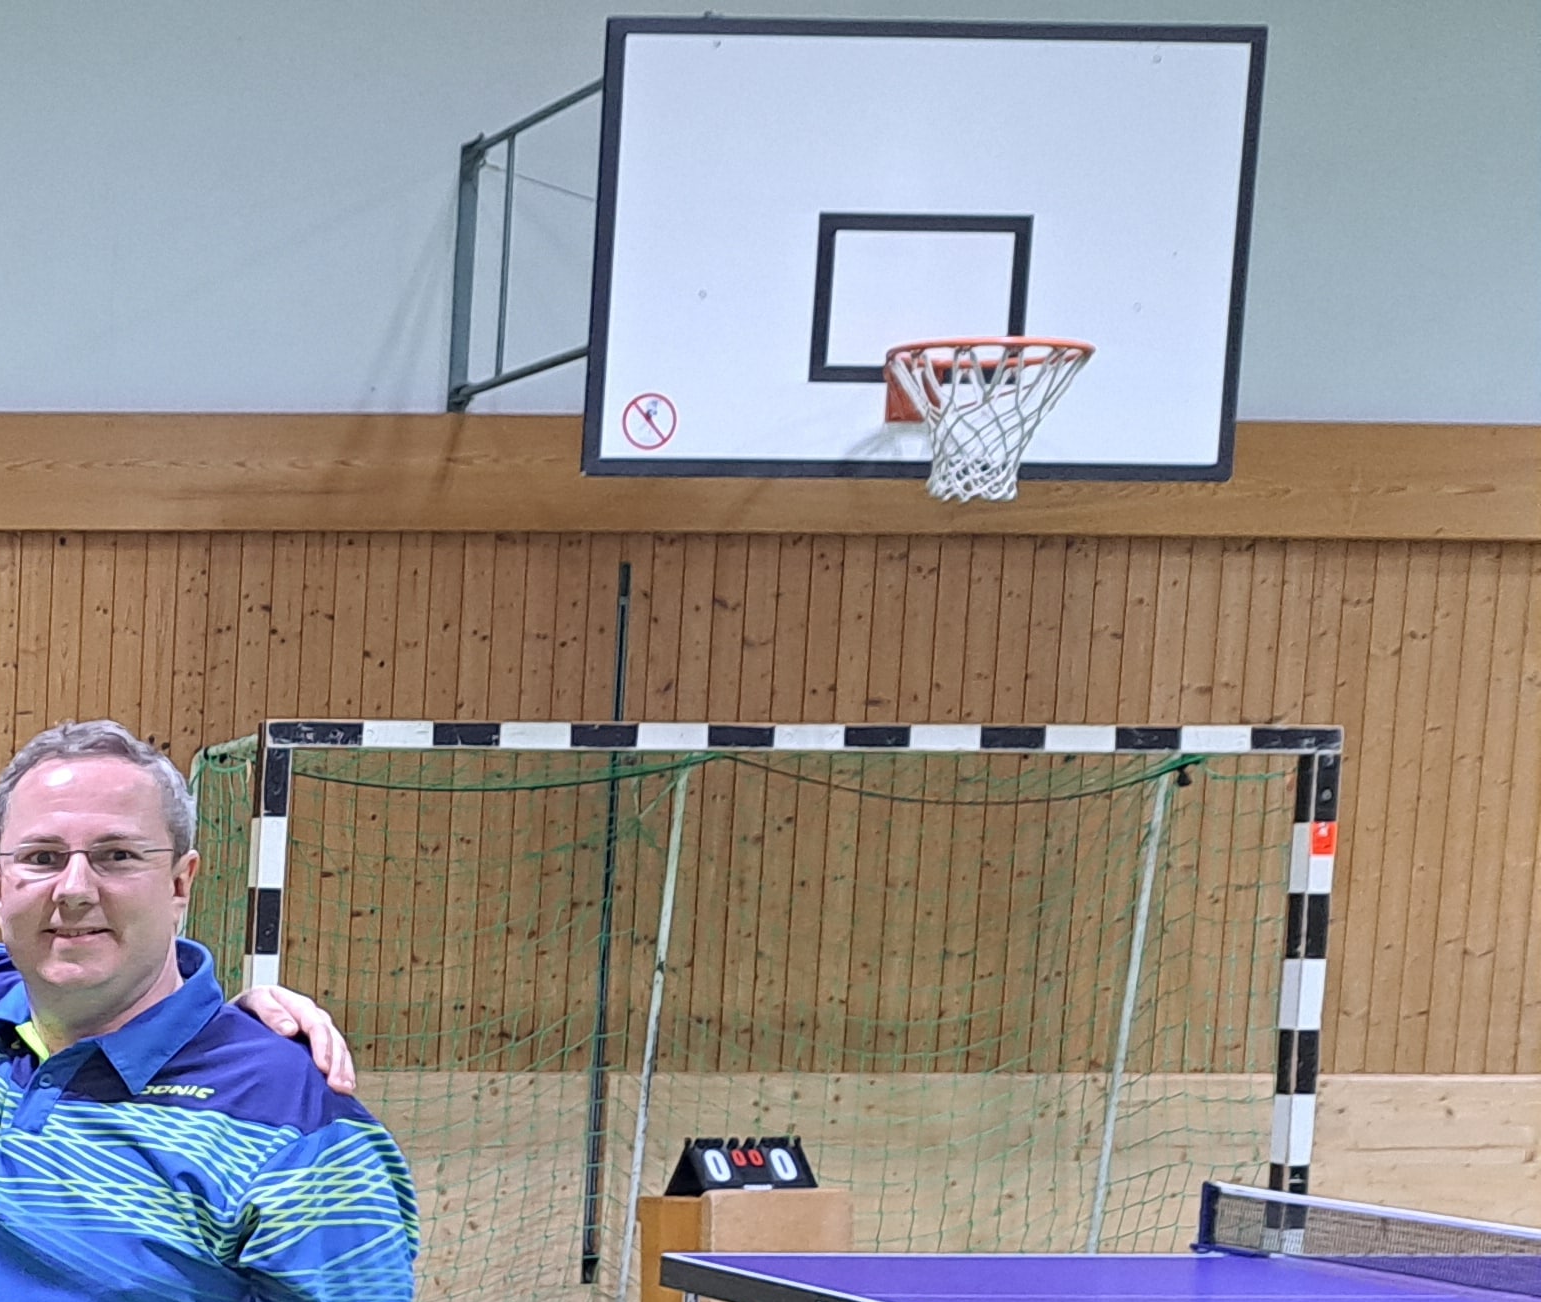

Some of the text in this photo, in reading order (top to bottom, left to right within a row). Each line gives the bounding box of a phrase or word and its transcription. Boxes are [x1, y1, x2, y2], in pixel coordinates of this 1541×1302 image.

[704, 1148, 798, 1182] 0 0 0 0
